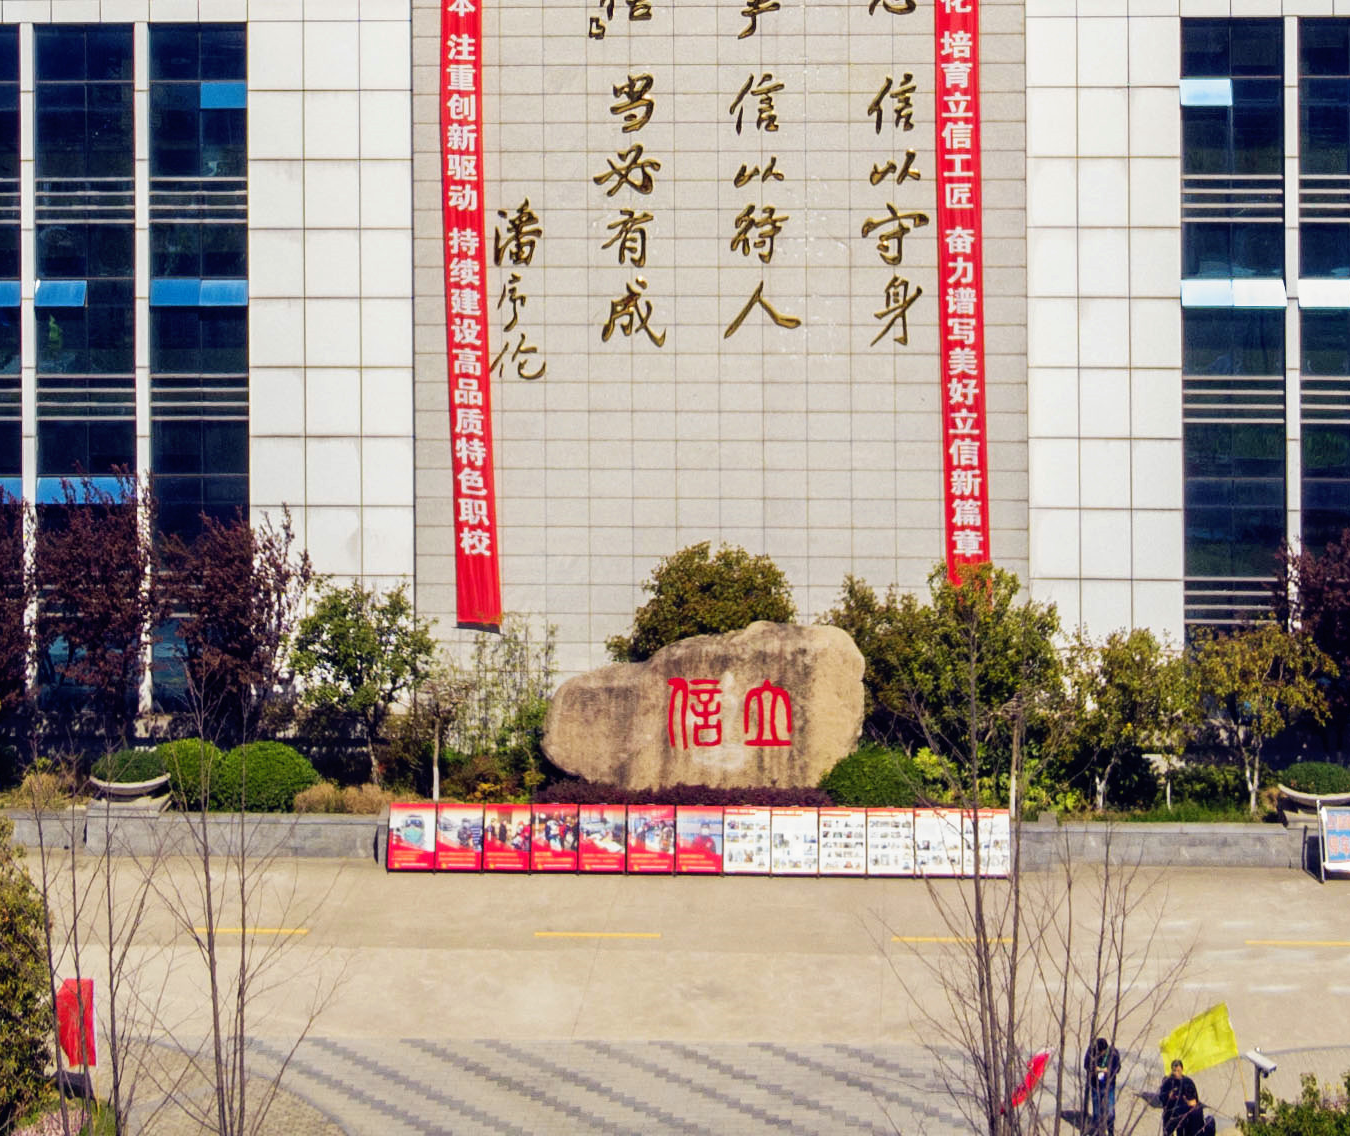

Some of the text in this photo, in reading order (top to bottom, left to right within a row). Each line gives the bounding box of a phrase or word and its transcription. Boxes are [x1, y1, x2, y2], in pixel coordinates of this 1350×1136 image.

[446, 33, 478, 211] 注重创新驱动
[724, 72, 802, 340] 信以待人
[861, 72, 930, 348] 信以守身
[940, 30, 974, 209] 培育立信工匠
[448, 227, 492, 556] 持续建设高品质特色职校
[945, 226, 984, 557] 奋力谱写美好立信新篇章
